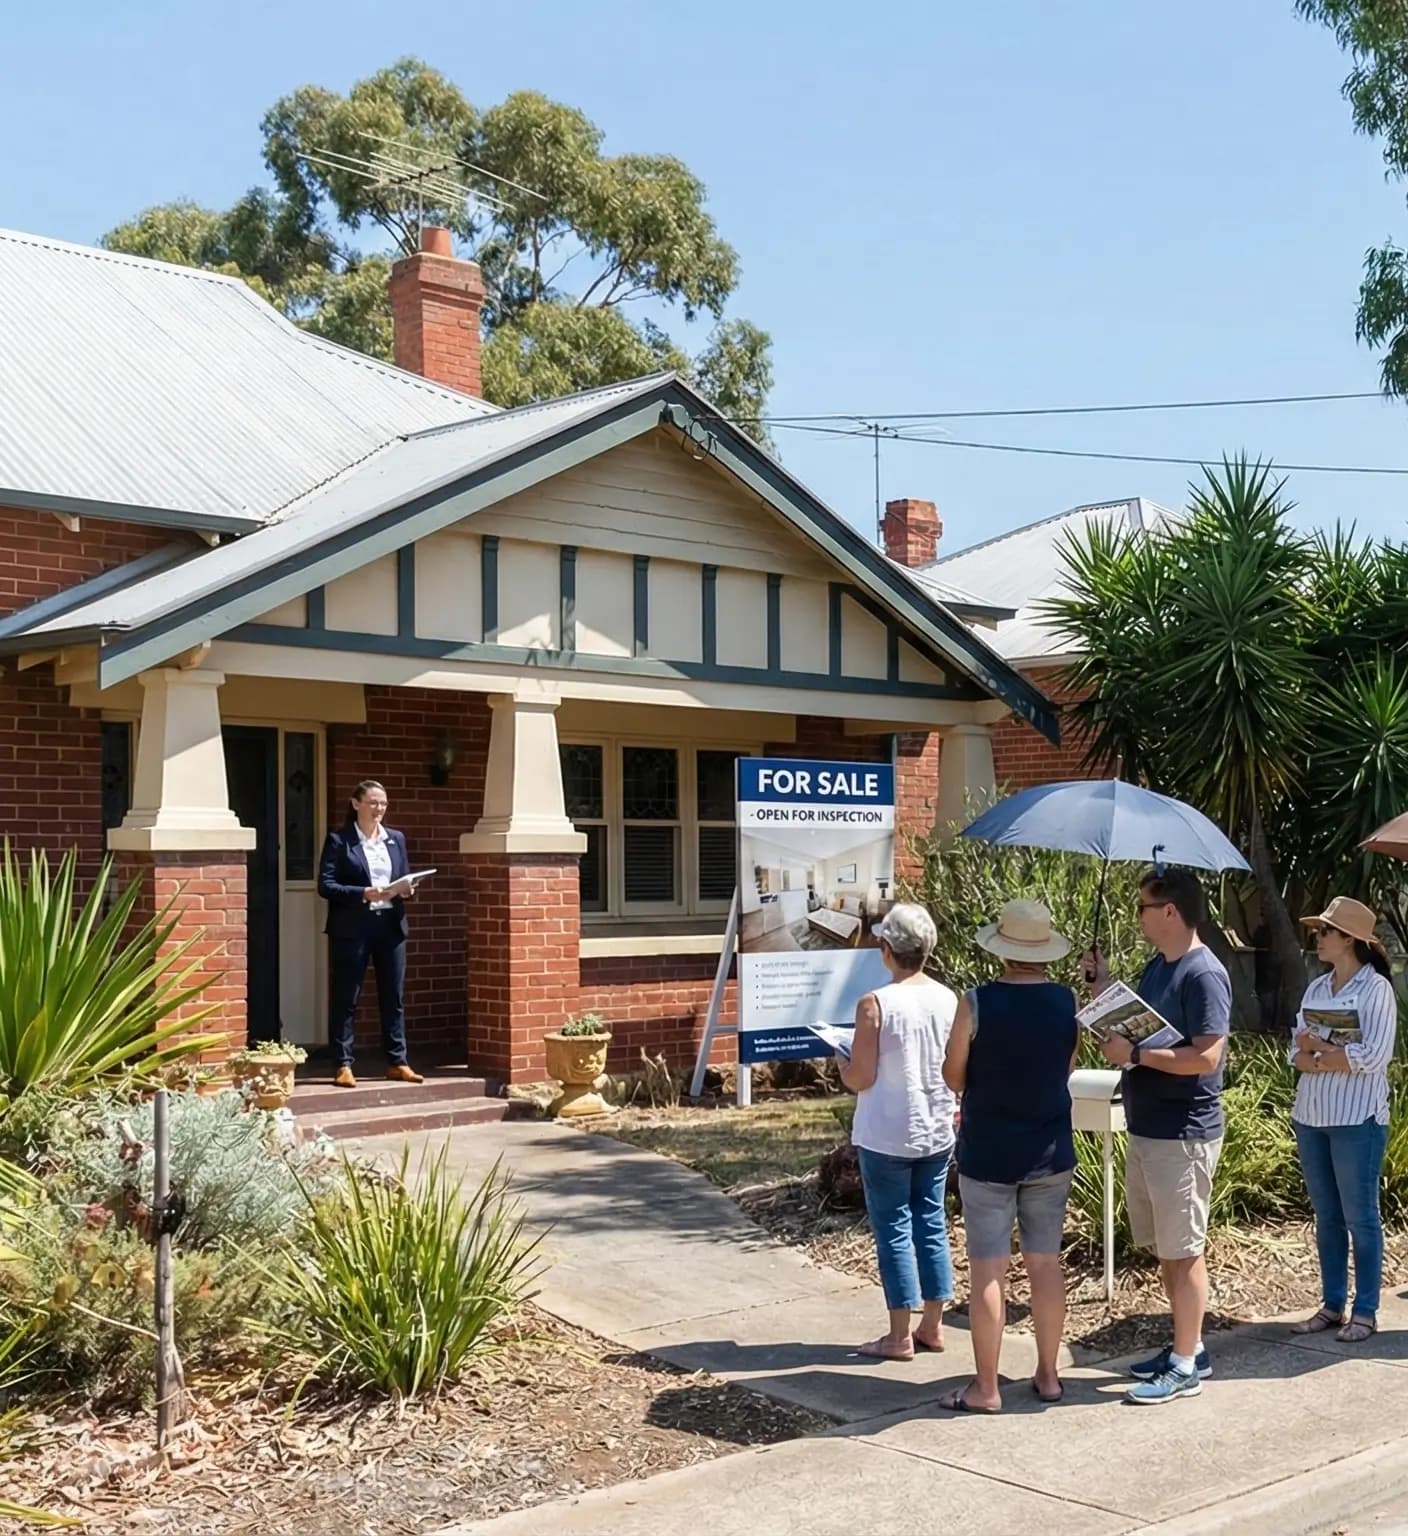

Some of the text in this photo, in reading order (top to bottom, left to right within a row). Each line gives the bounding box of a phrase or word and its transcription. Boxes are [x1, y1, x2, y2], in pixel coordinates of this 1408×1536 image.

[758, 769, 879, 796] FOR SALE
[756, 808, 883, 823] OPEN FOR INSPECTION
